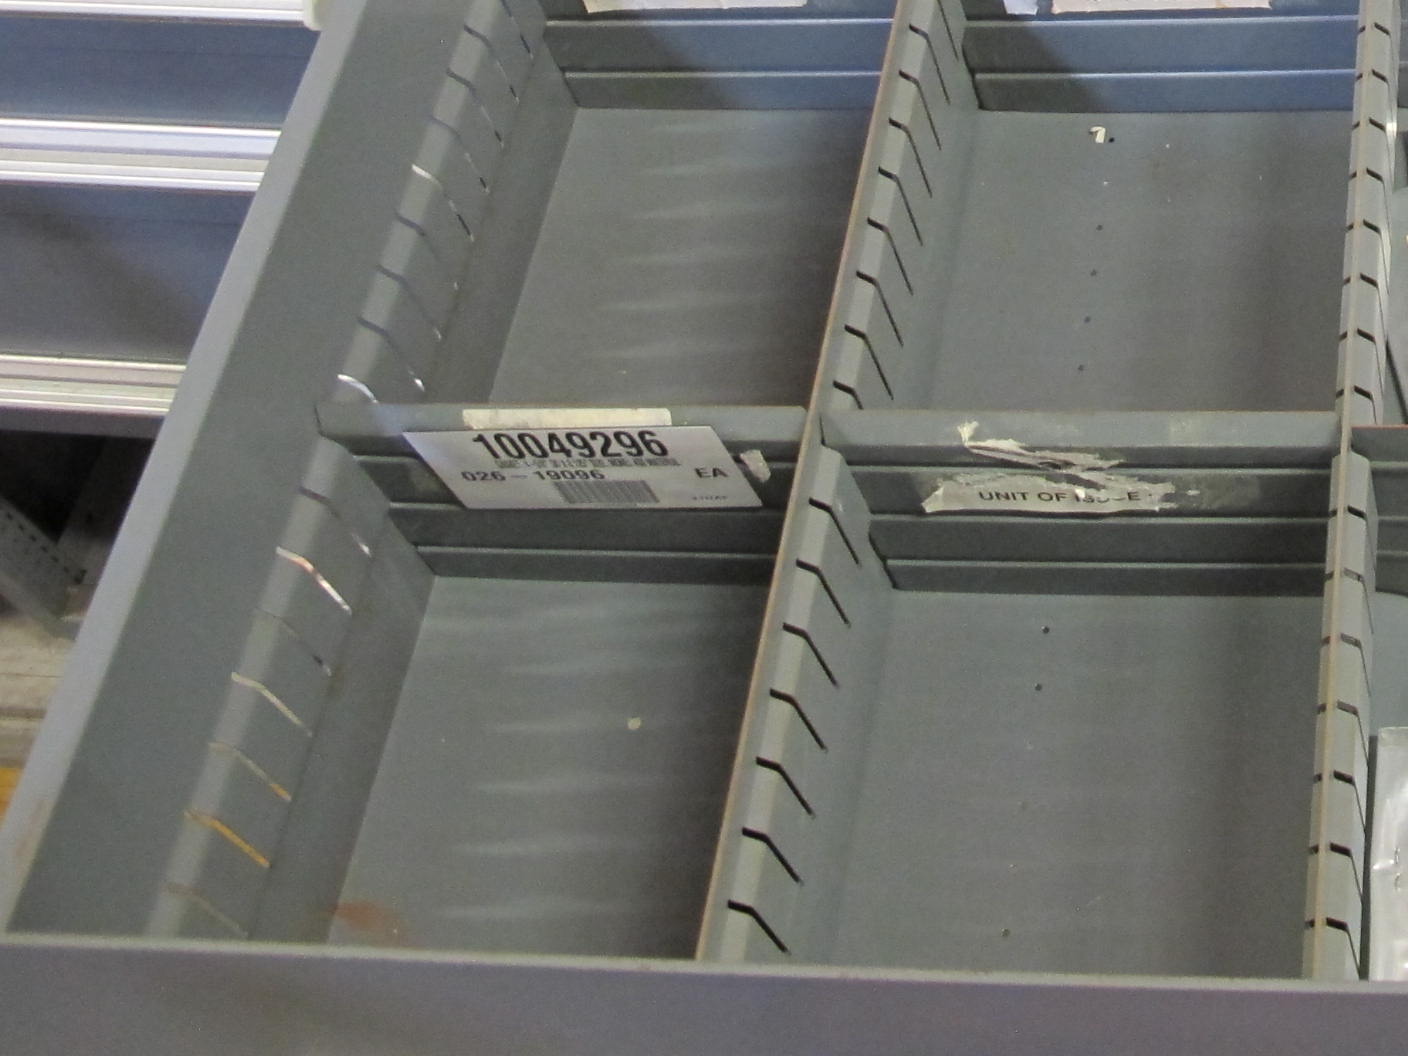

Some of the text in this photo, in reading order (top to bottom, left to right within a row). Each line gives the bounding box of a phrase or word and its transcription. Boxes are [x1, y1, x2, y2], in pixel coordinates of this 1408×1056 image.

[472, 430, 669, 459] 10049296
[695, 466, 729, 479] EA
[979, 491, 1028, 502] UNIT
[1038, 491, 1066, 502] OF
